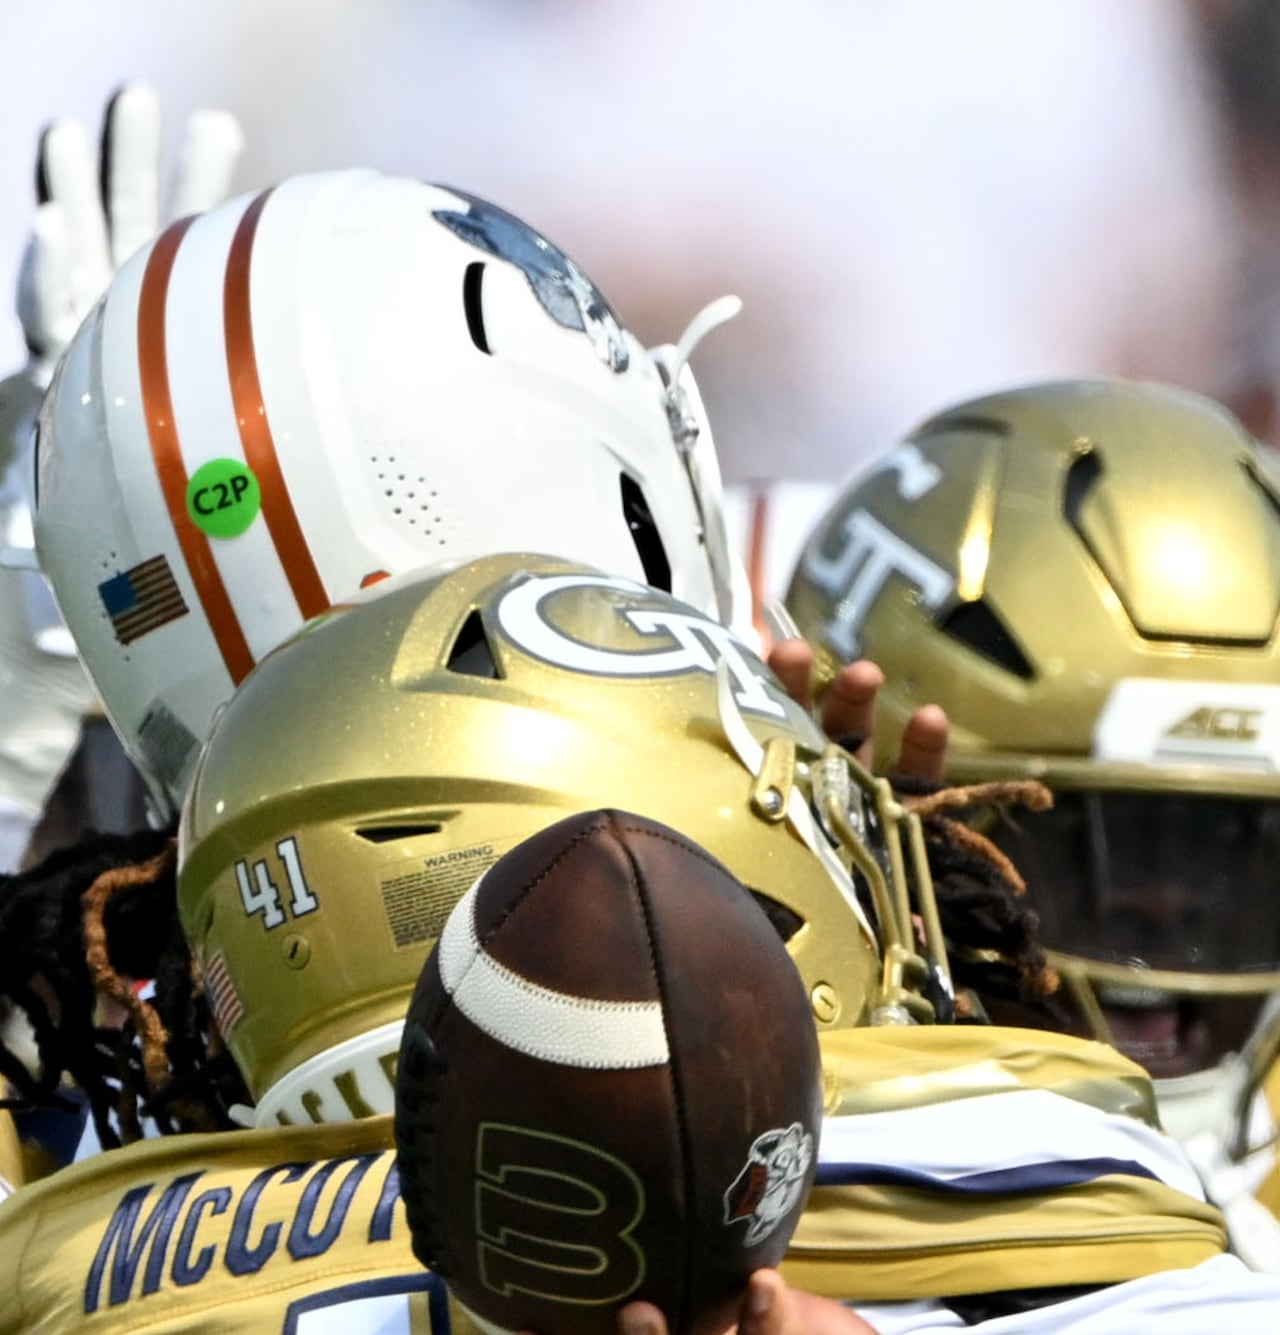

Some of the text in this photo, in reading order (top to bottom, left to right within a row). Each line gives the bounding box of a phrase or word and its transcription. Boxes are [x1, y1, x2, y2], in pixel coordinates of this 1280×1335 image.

[192, 474, 250, 516] C2P
[1166, 705, 1266, 740] ACC
[424, 844, 494, 869] WARNING
[234, 835, 320, 932] 41
